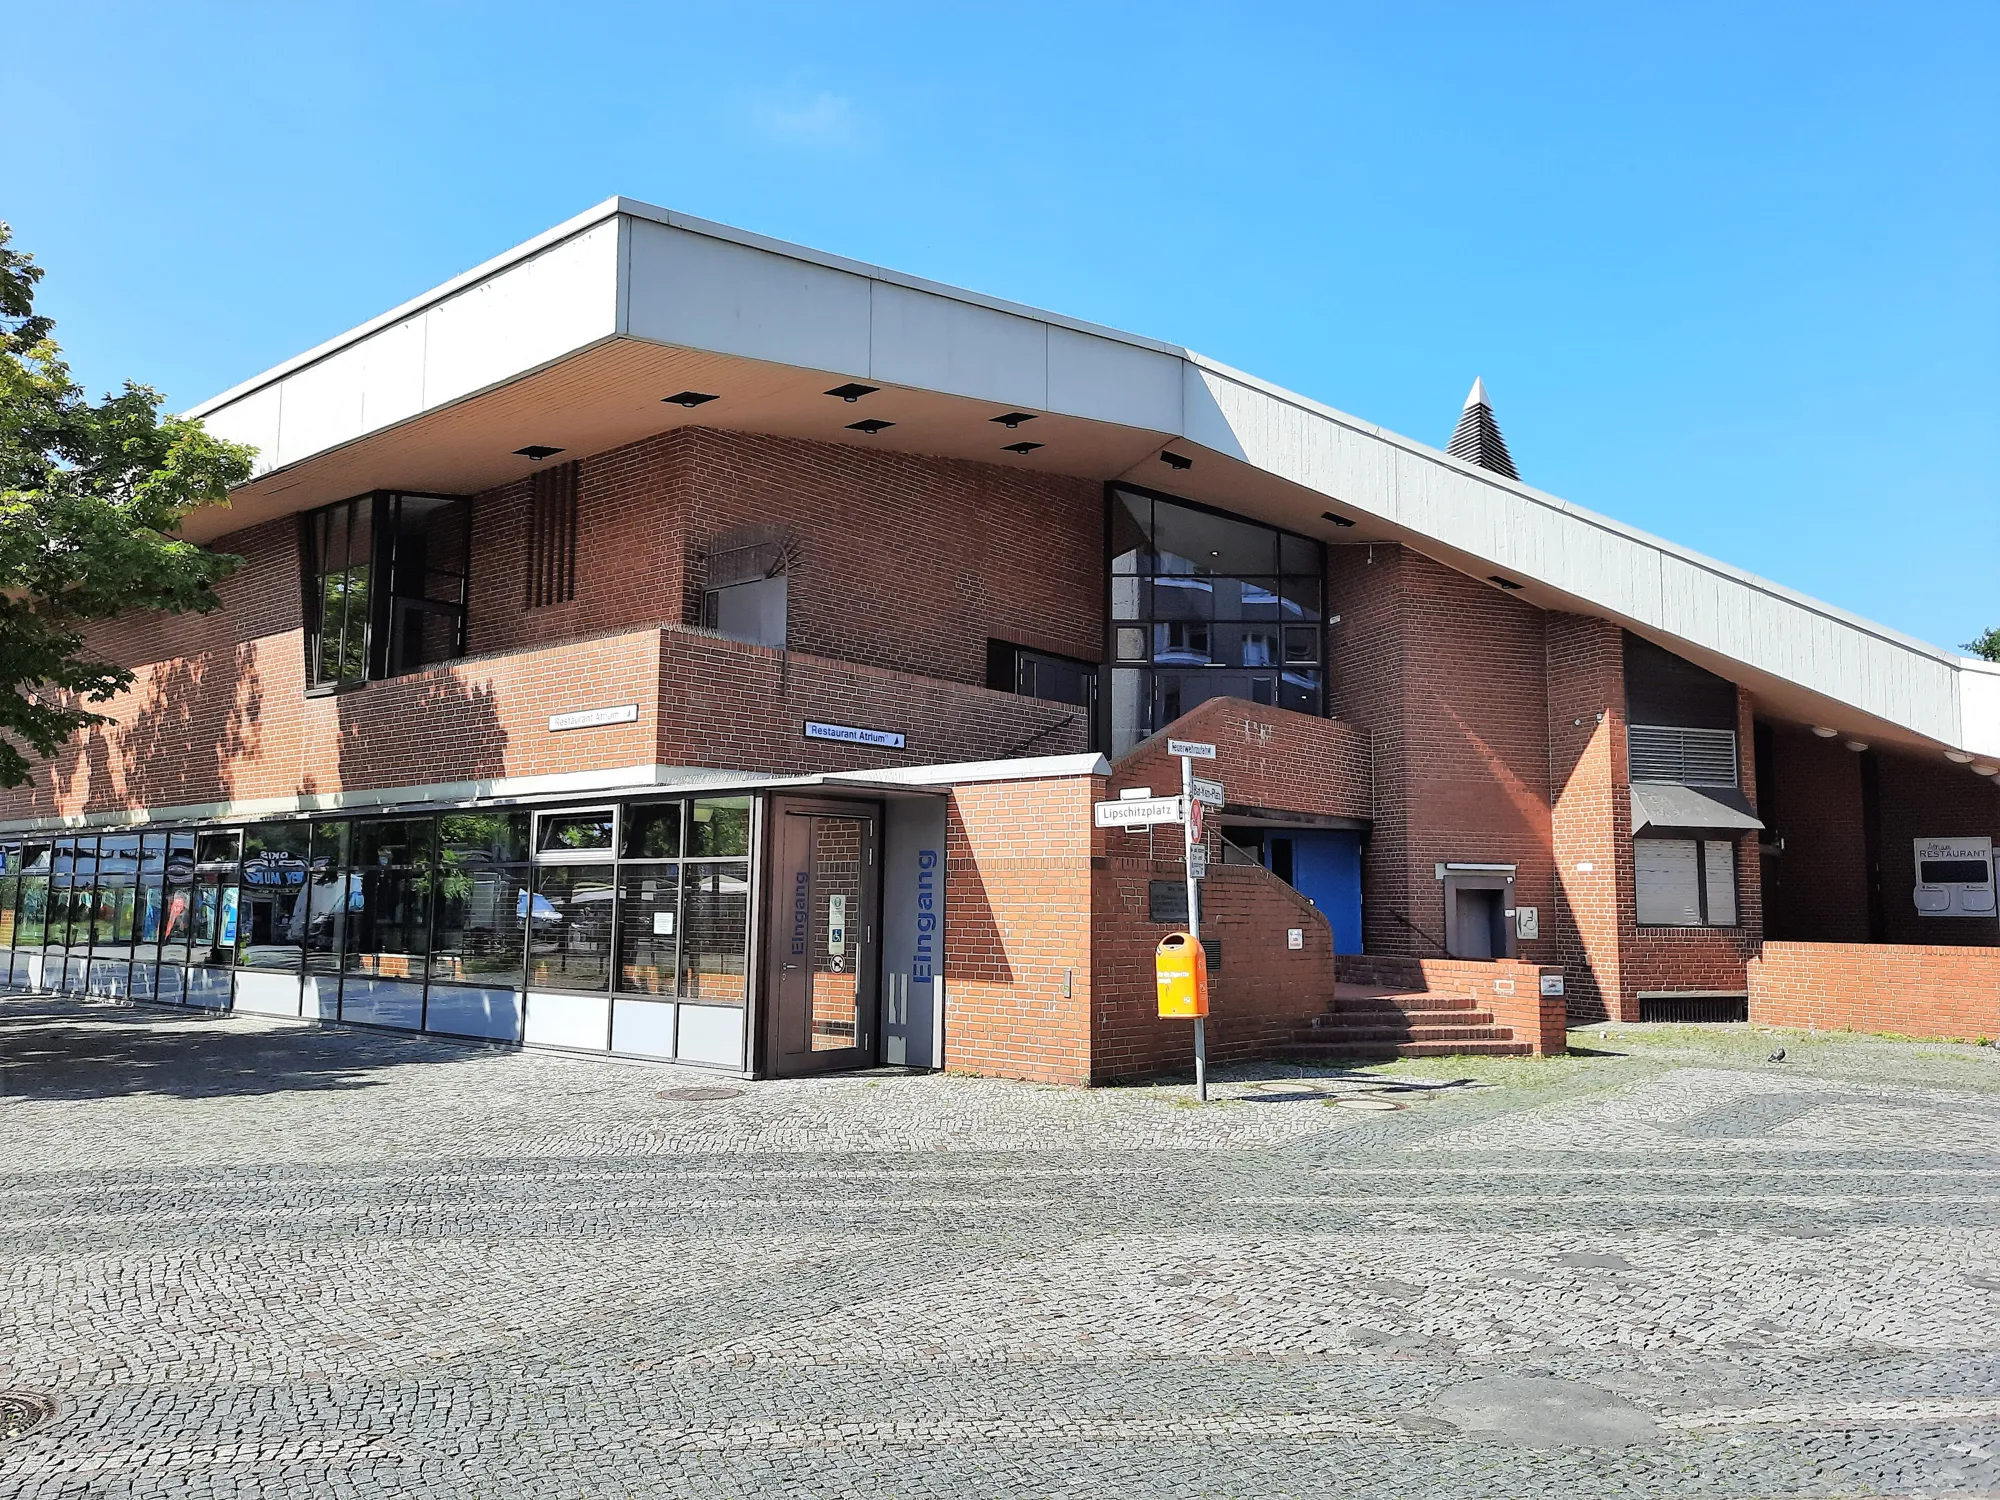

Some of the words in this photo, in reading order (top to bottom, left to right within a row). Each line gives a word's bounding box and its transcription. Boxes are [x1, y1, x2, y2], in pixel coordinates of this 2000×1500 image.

[554, 714, 593, 726] Restaurant
[1103, 804, 1172, 820] Lipschitzplatz
[1919, 850, 1986, 858] RESTAURANT
[792, 872, 809, 955] Eingang
[913, 850, 937, 983] Eingang
